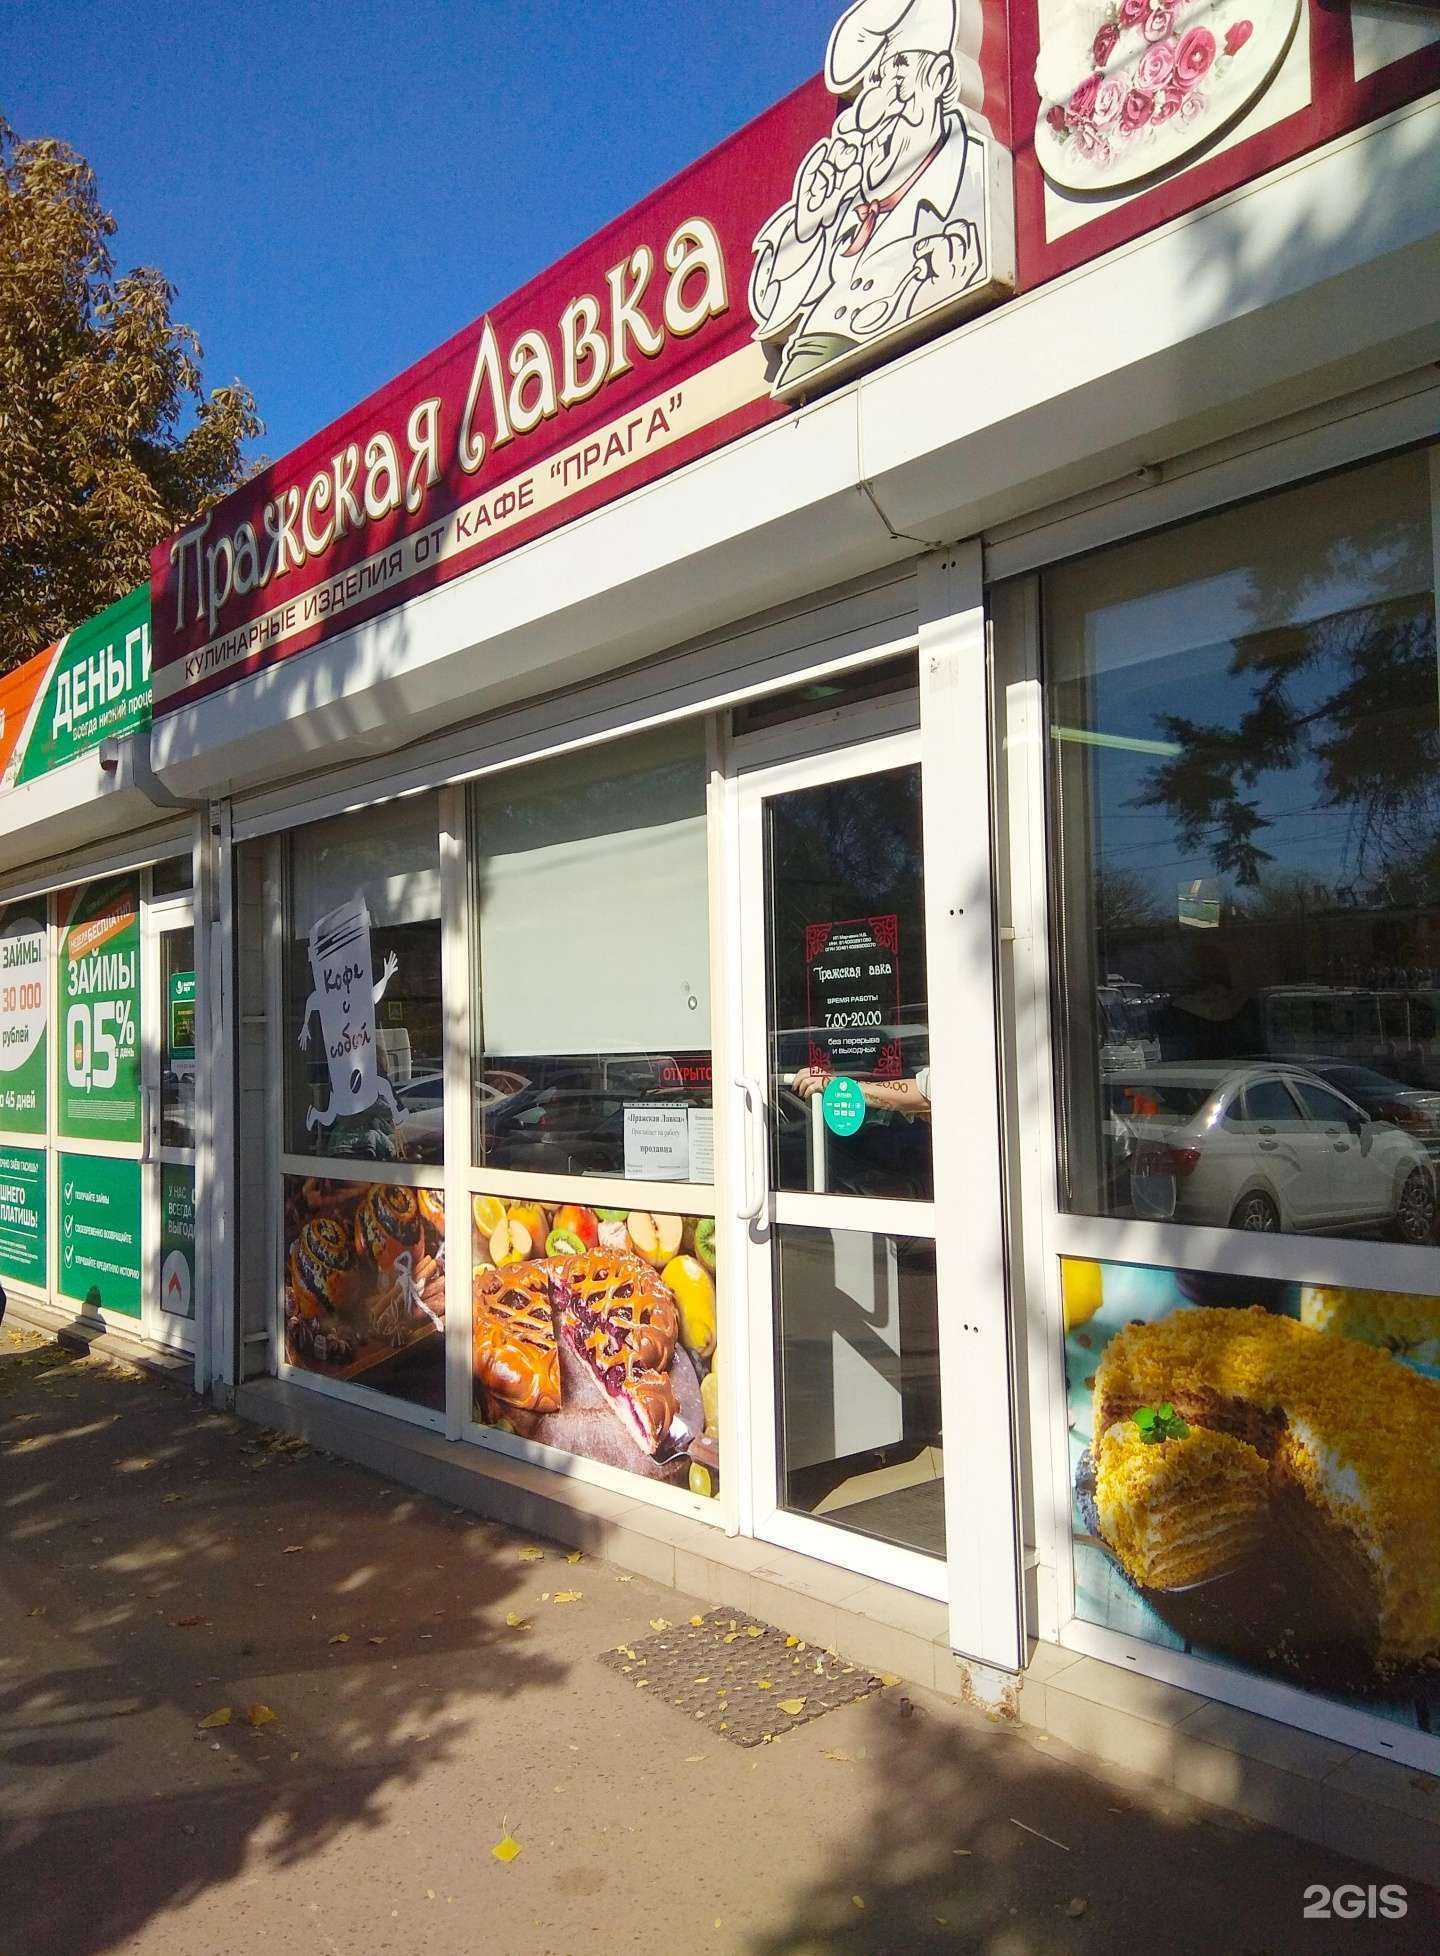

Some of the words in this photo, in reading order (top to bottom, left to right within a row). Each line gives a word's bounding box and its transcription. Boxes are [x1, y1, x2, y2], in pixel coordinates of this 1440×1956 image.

[170, 397, 442, 635] Пражская
[458, 216, 729, 474] Лавка
[184, 610, 297, 680] КУЛИНАРНЫЕ
[304, 550, 403, 621] ИЗДЕЛИЯ
[415, 527, 445, 564] ОТ
[456, 478, 534, 538] КАФЕ
[3, 938, 41, 968] ЗАЙМЫ
[67, 947, 135, 997] ЗАЙМЫ
[323, 963, 364, 994] Кофе
[20, 982, 42, 1011] 000
[343, 1001, 350, 1014] с
[827, 996, 849, 1004] ВРЕМЯ
[851, 995, 878, 1003] РАБОТЫ
[825, 1011, 881, 1028] 7.00-20.00
[2, 1024, 29, 1047] рублей
[839, 1047, 876, 1055] выходных
[168, 1202, 192, 1218] ВСЕГДА
